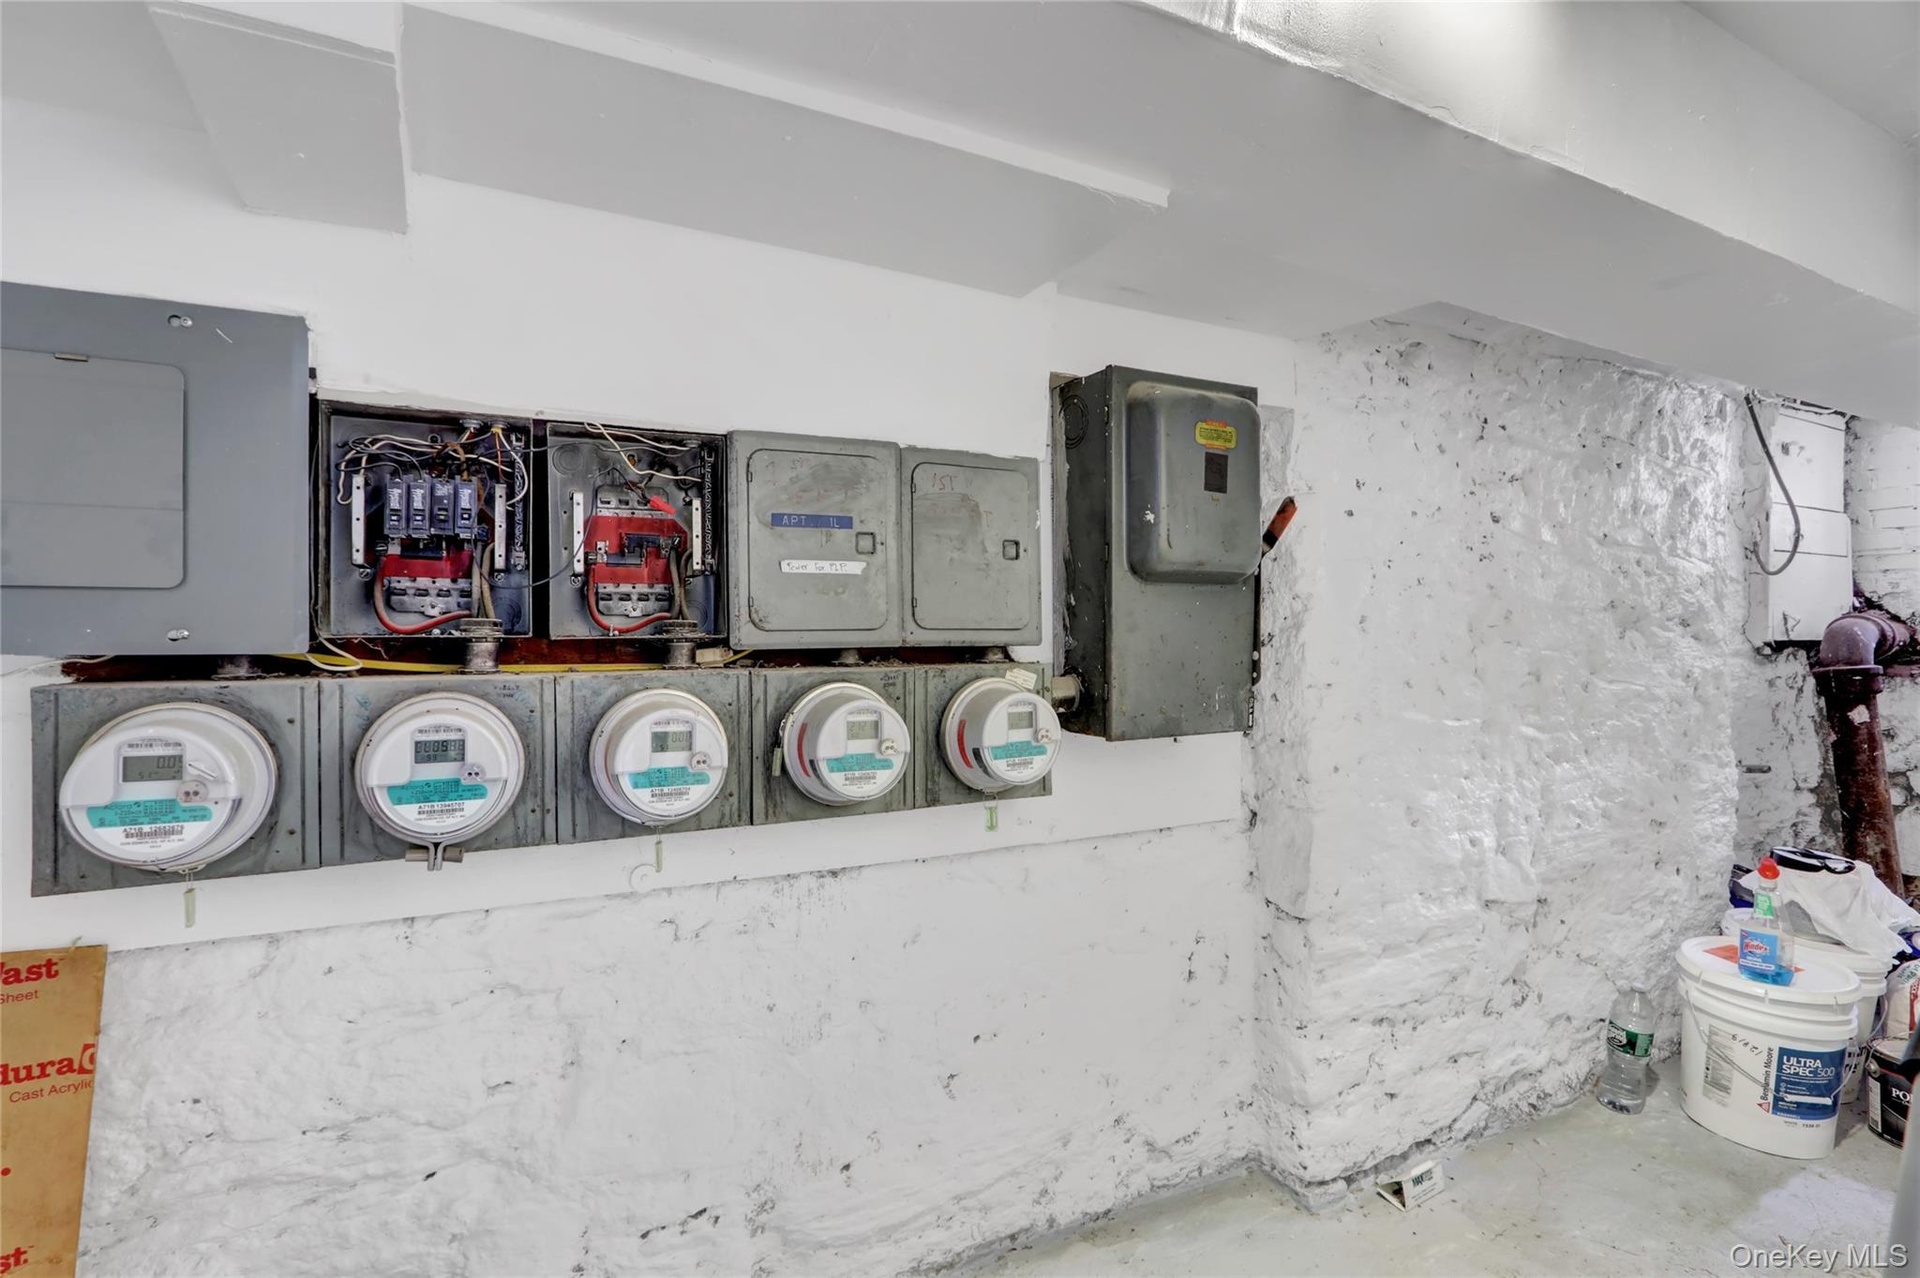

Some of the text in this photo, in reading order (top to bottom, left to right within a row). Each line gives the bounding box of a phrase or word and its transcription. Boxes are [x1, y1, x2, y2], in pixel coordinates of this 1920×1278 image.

[1764, 1046, 1774, 1070] Moore
[1783, 1055, 1822, 1068] ULTRA
[1781, 1064, 1836, 1077] SPEC 500
[9, 1088, 44, 1103] Cast
